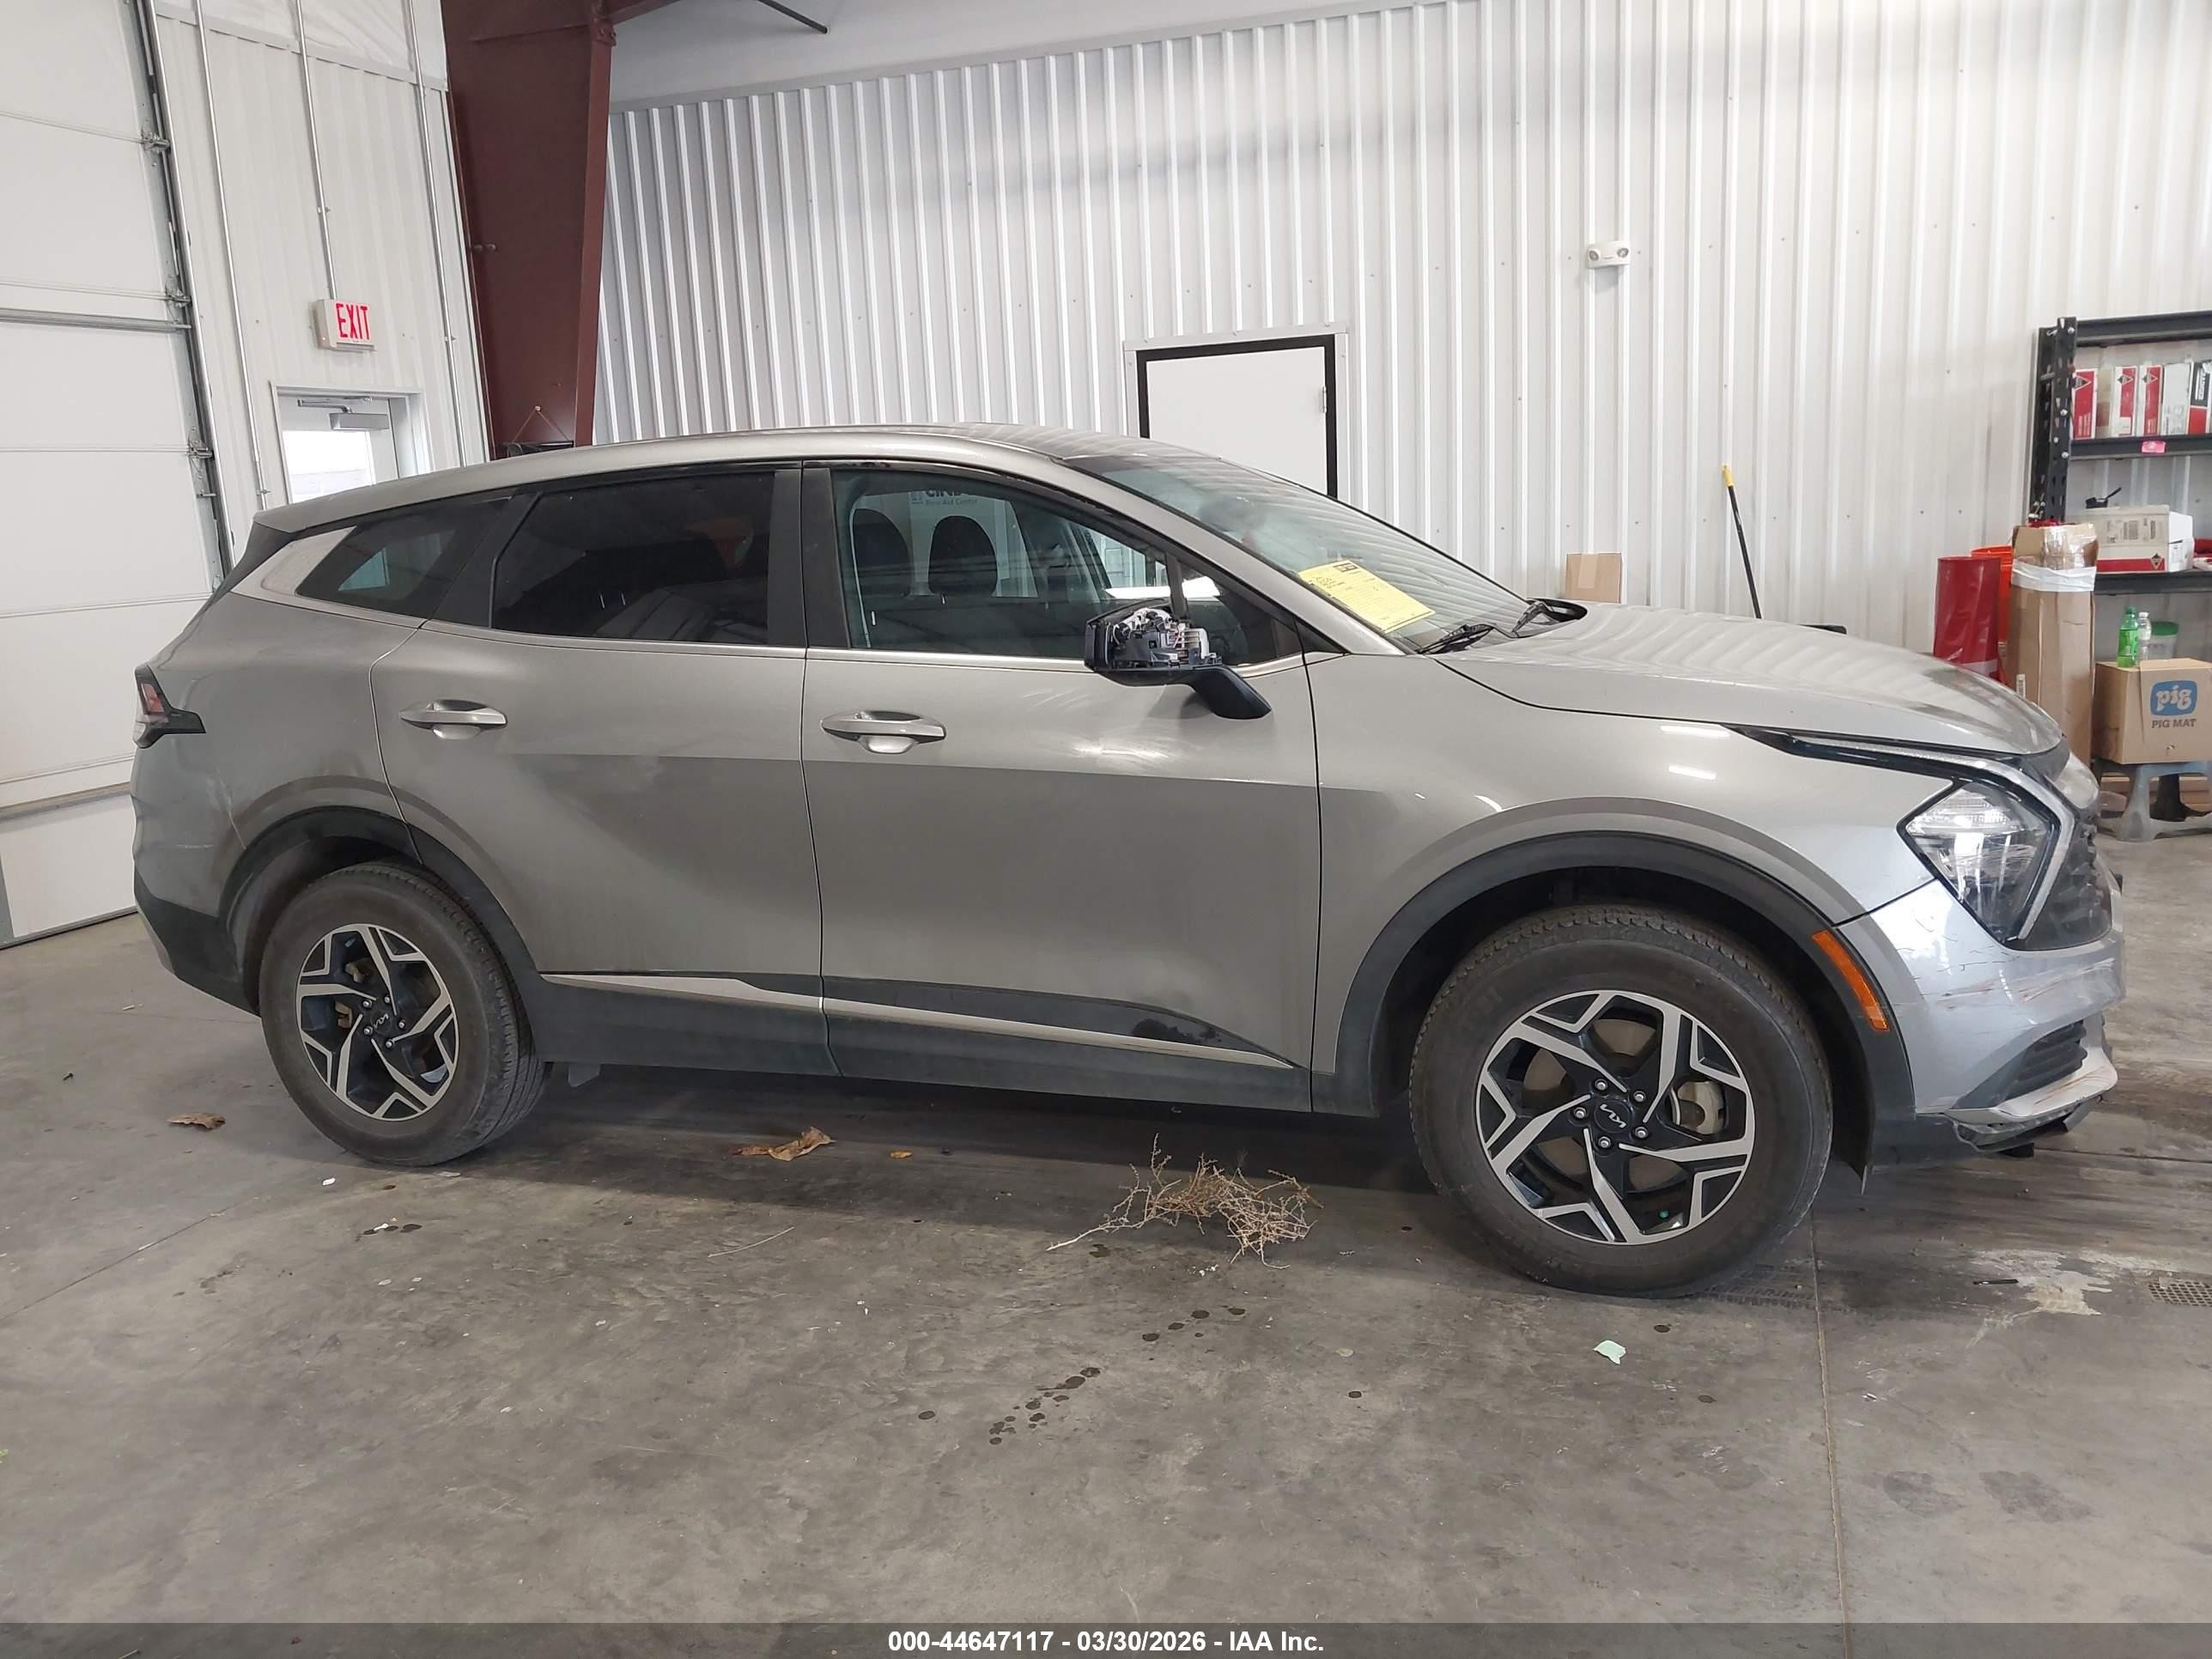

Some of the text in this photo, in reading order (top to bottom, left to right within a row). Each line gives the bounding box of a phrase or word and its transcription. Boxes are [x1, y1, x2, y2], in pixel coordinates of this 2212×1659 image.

[336, 303, 369, 340] EXIT
[2156, 684, 2191, 712] pig
[2151, 718, 2197, 729] PIG MAT
